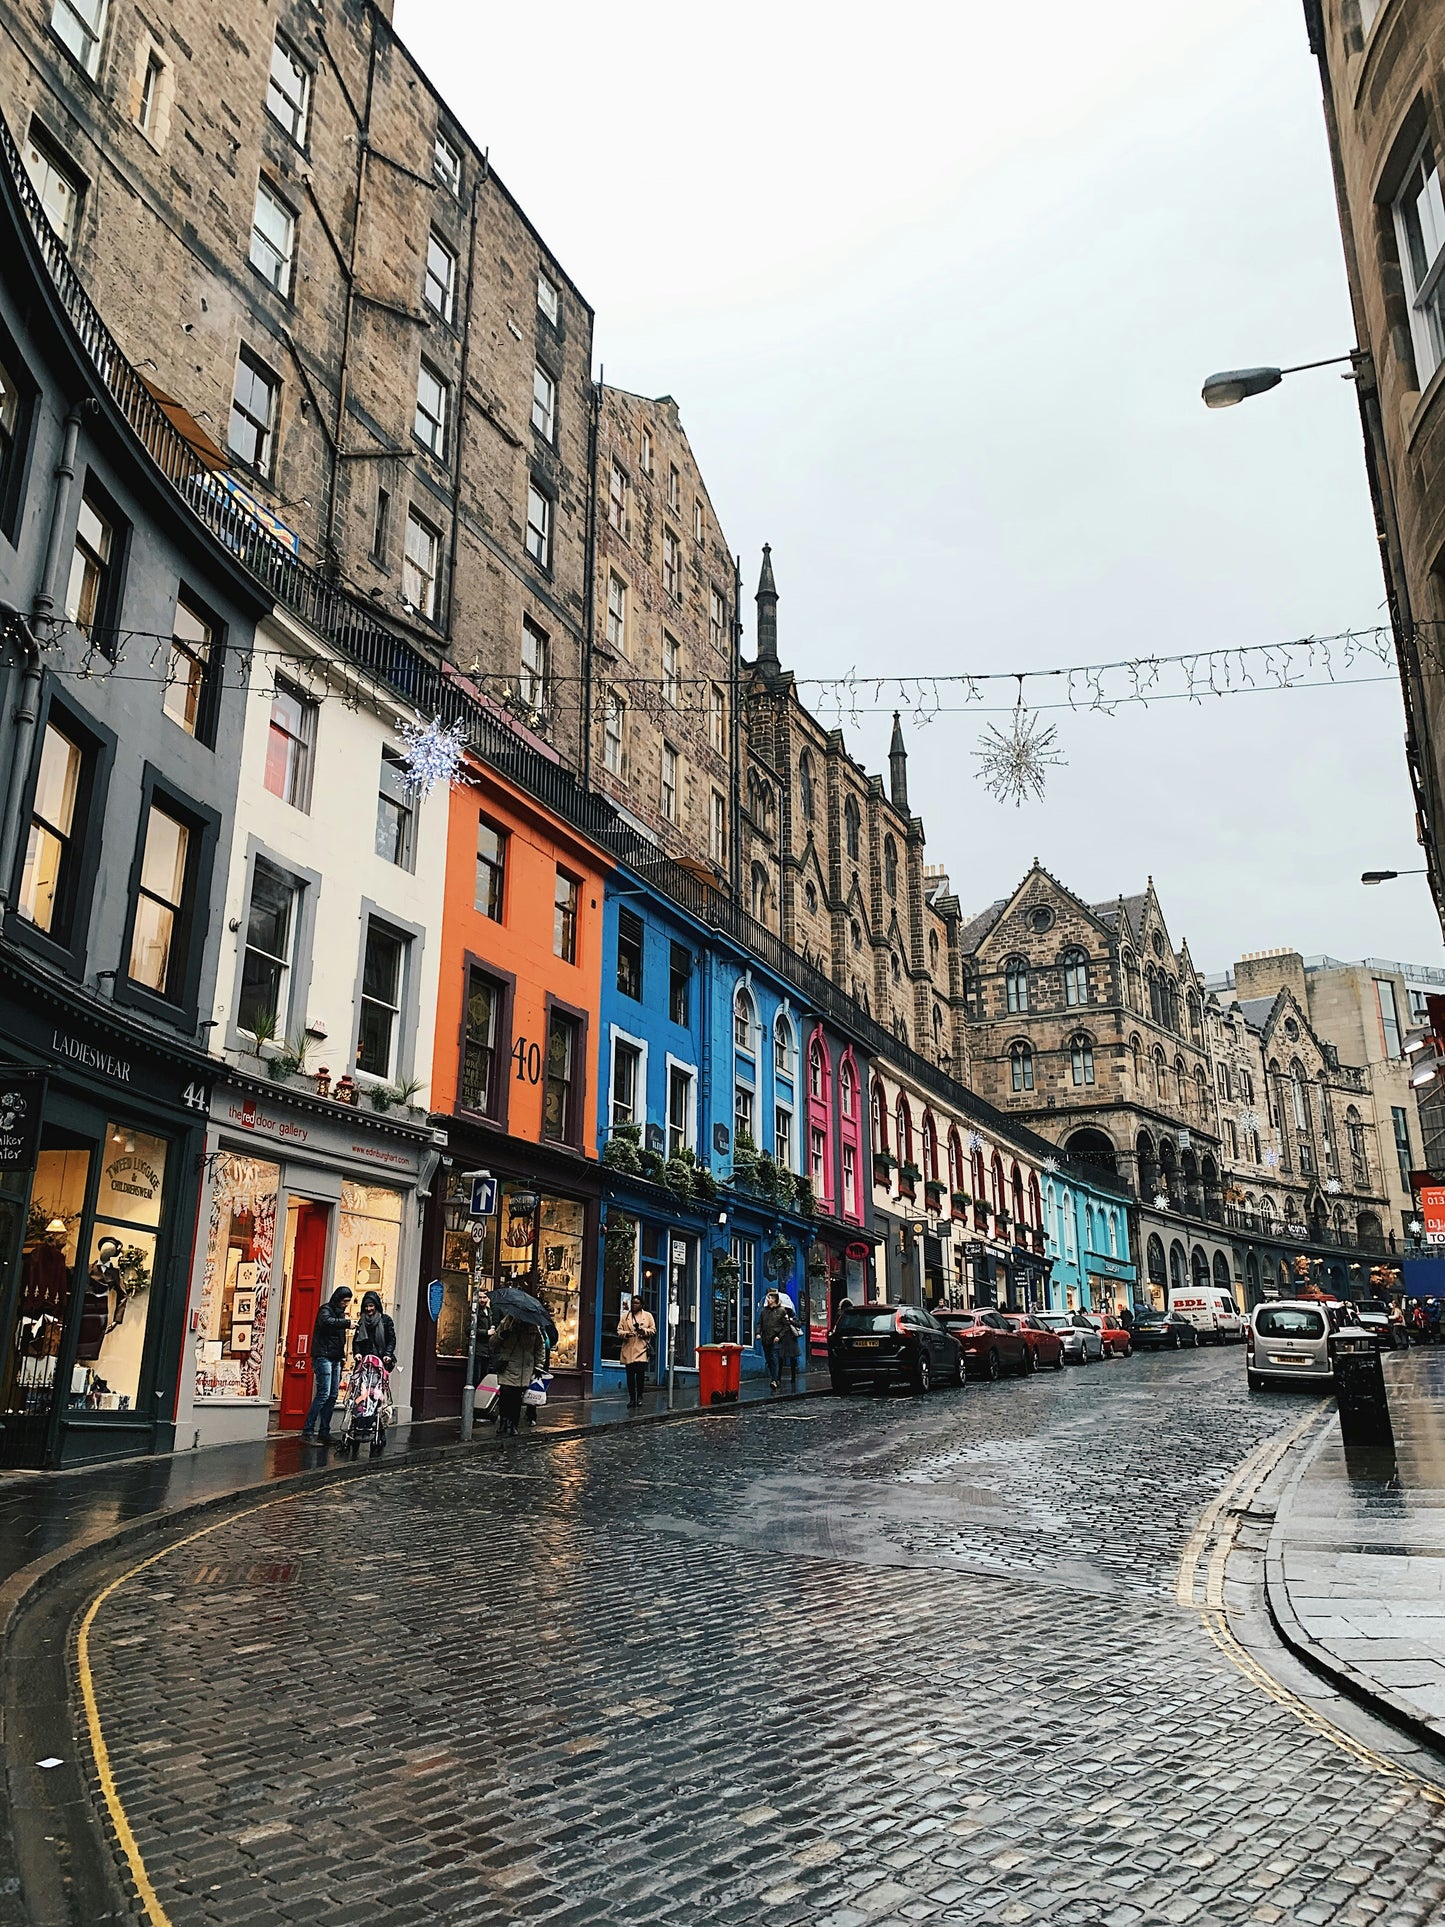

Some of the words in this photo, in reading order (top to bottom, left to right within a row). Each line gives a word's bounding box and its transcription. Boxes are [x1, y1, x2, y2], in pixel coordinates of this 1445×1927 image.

[52, 1030, 131, 1082] LADIESWEAR
[228, 1104, 242, 1120] the
[242, 1110, 255, 1124] red
[256, 1113, 276, 1130] door
[279, 1121, 308, 1141] gallery
[352, 1145, 410, 1165] www.edinburghart.com
[106, 1156, 132, 1180] TWEED
[133, 1157, 160, 1192] LUGGAGE
[473, 1227, 483, 1238] 20
[1430, 1233, 1445, 1243] TO
[1173, 1298, 1207, 1308] BDL
[295, 1360, 306, 1370] 42
